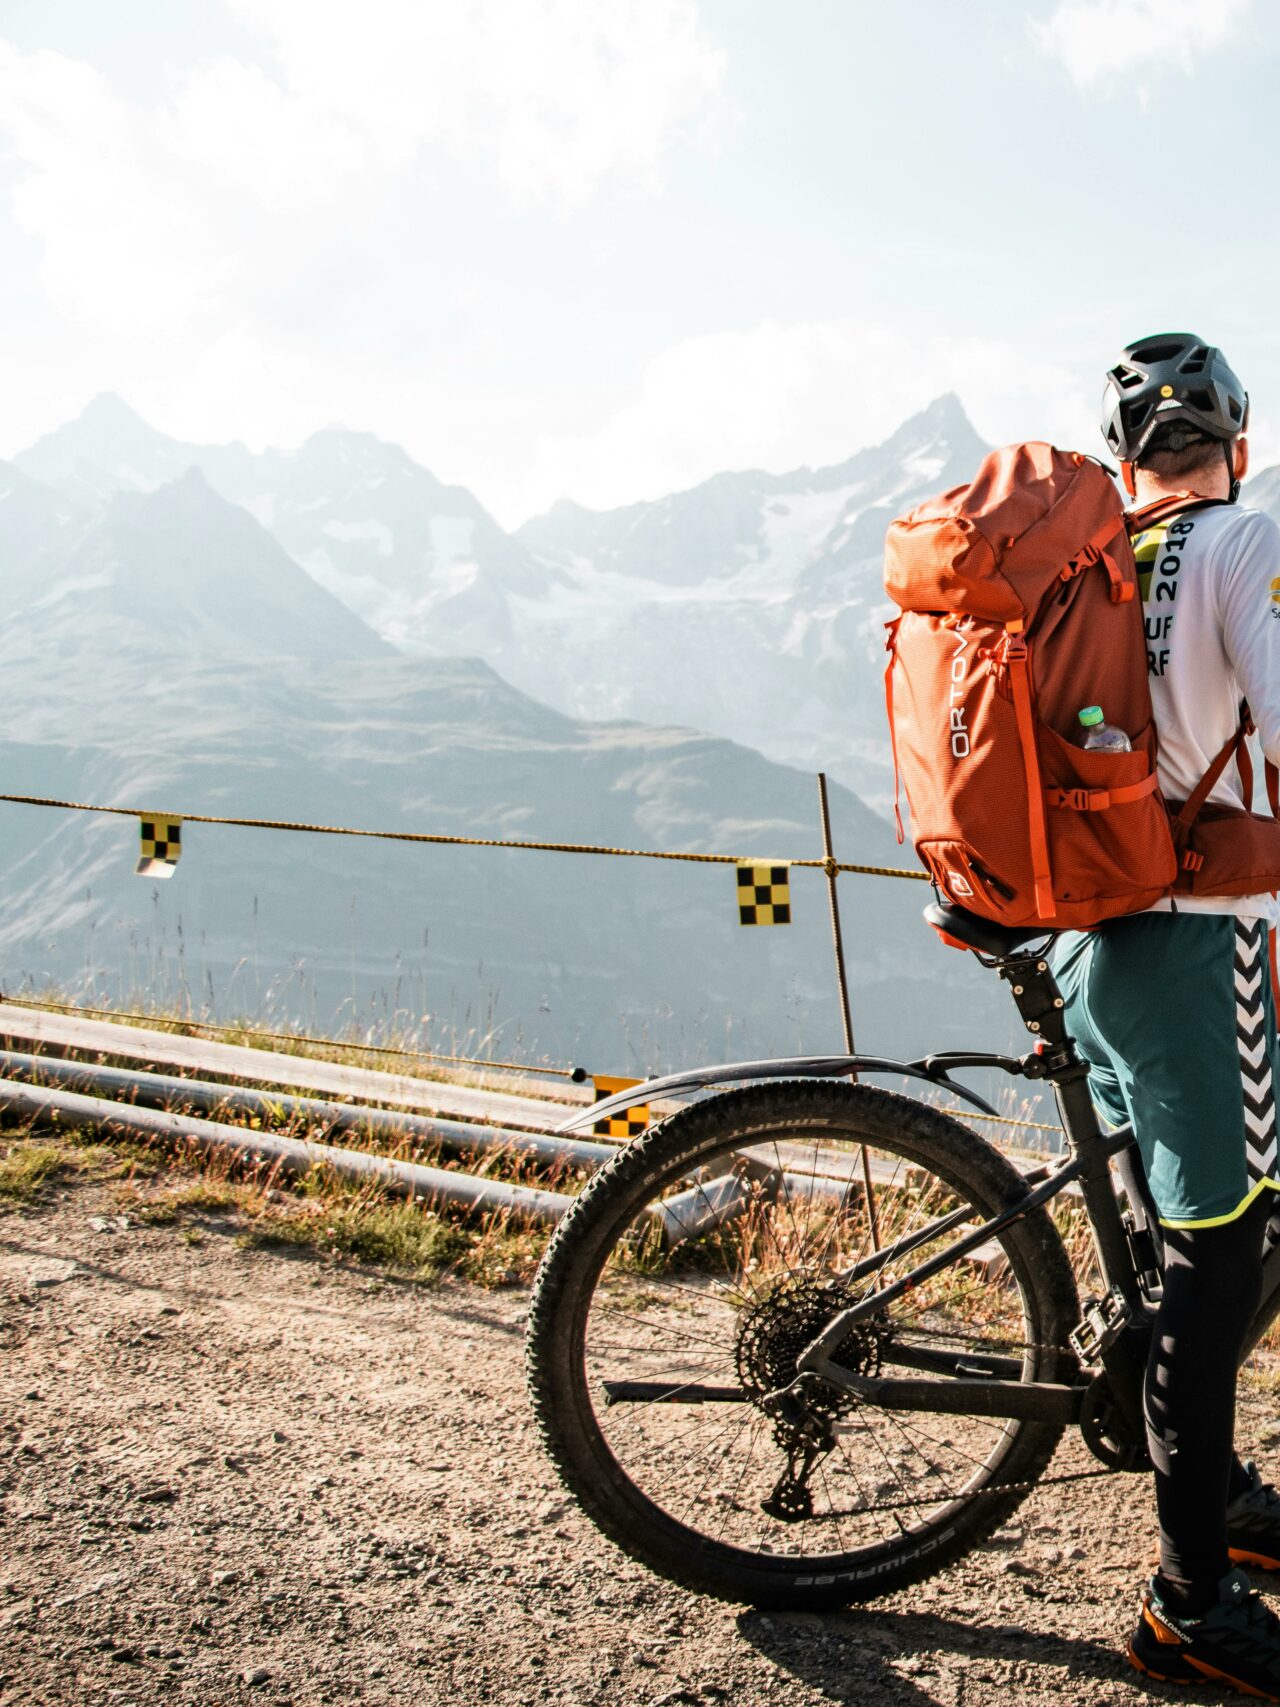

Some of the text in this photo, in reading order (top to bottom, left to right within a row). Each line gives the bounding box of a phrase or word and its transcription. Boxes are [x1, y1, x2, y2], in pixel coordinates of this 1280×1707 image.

[1156, 522, 1195, 602] 2018
[794, 1527, 956, 1586] SCHWALBE
[1154, 1610, 1194, 1644] SALOMON
